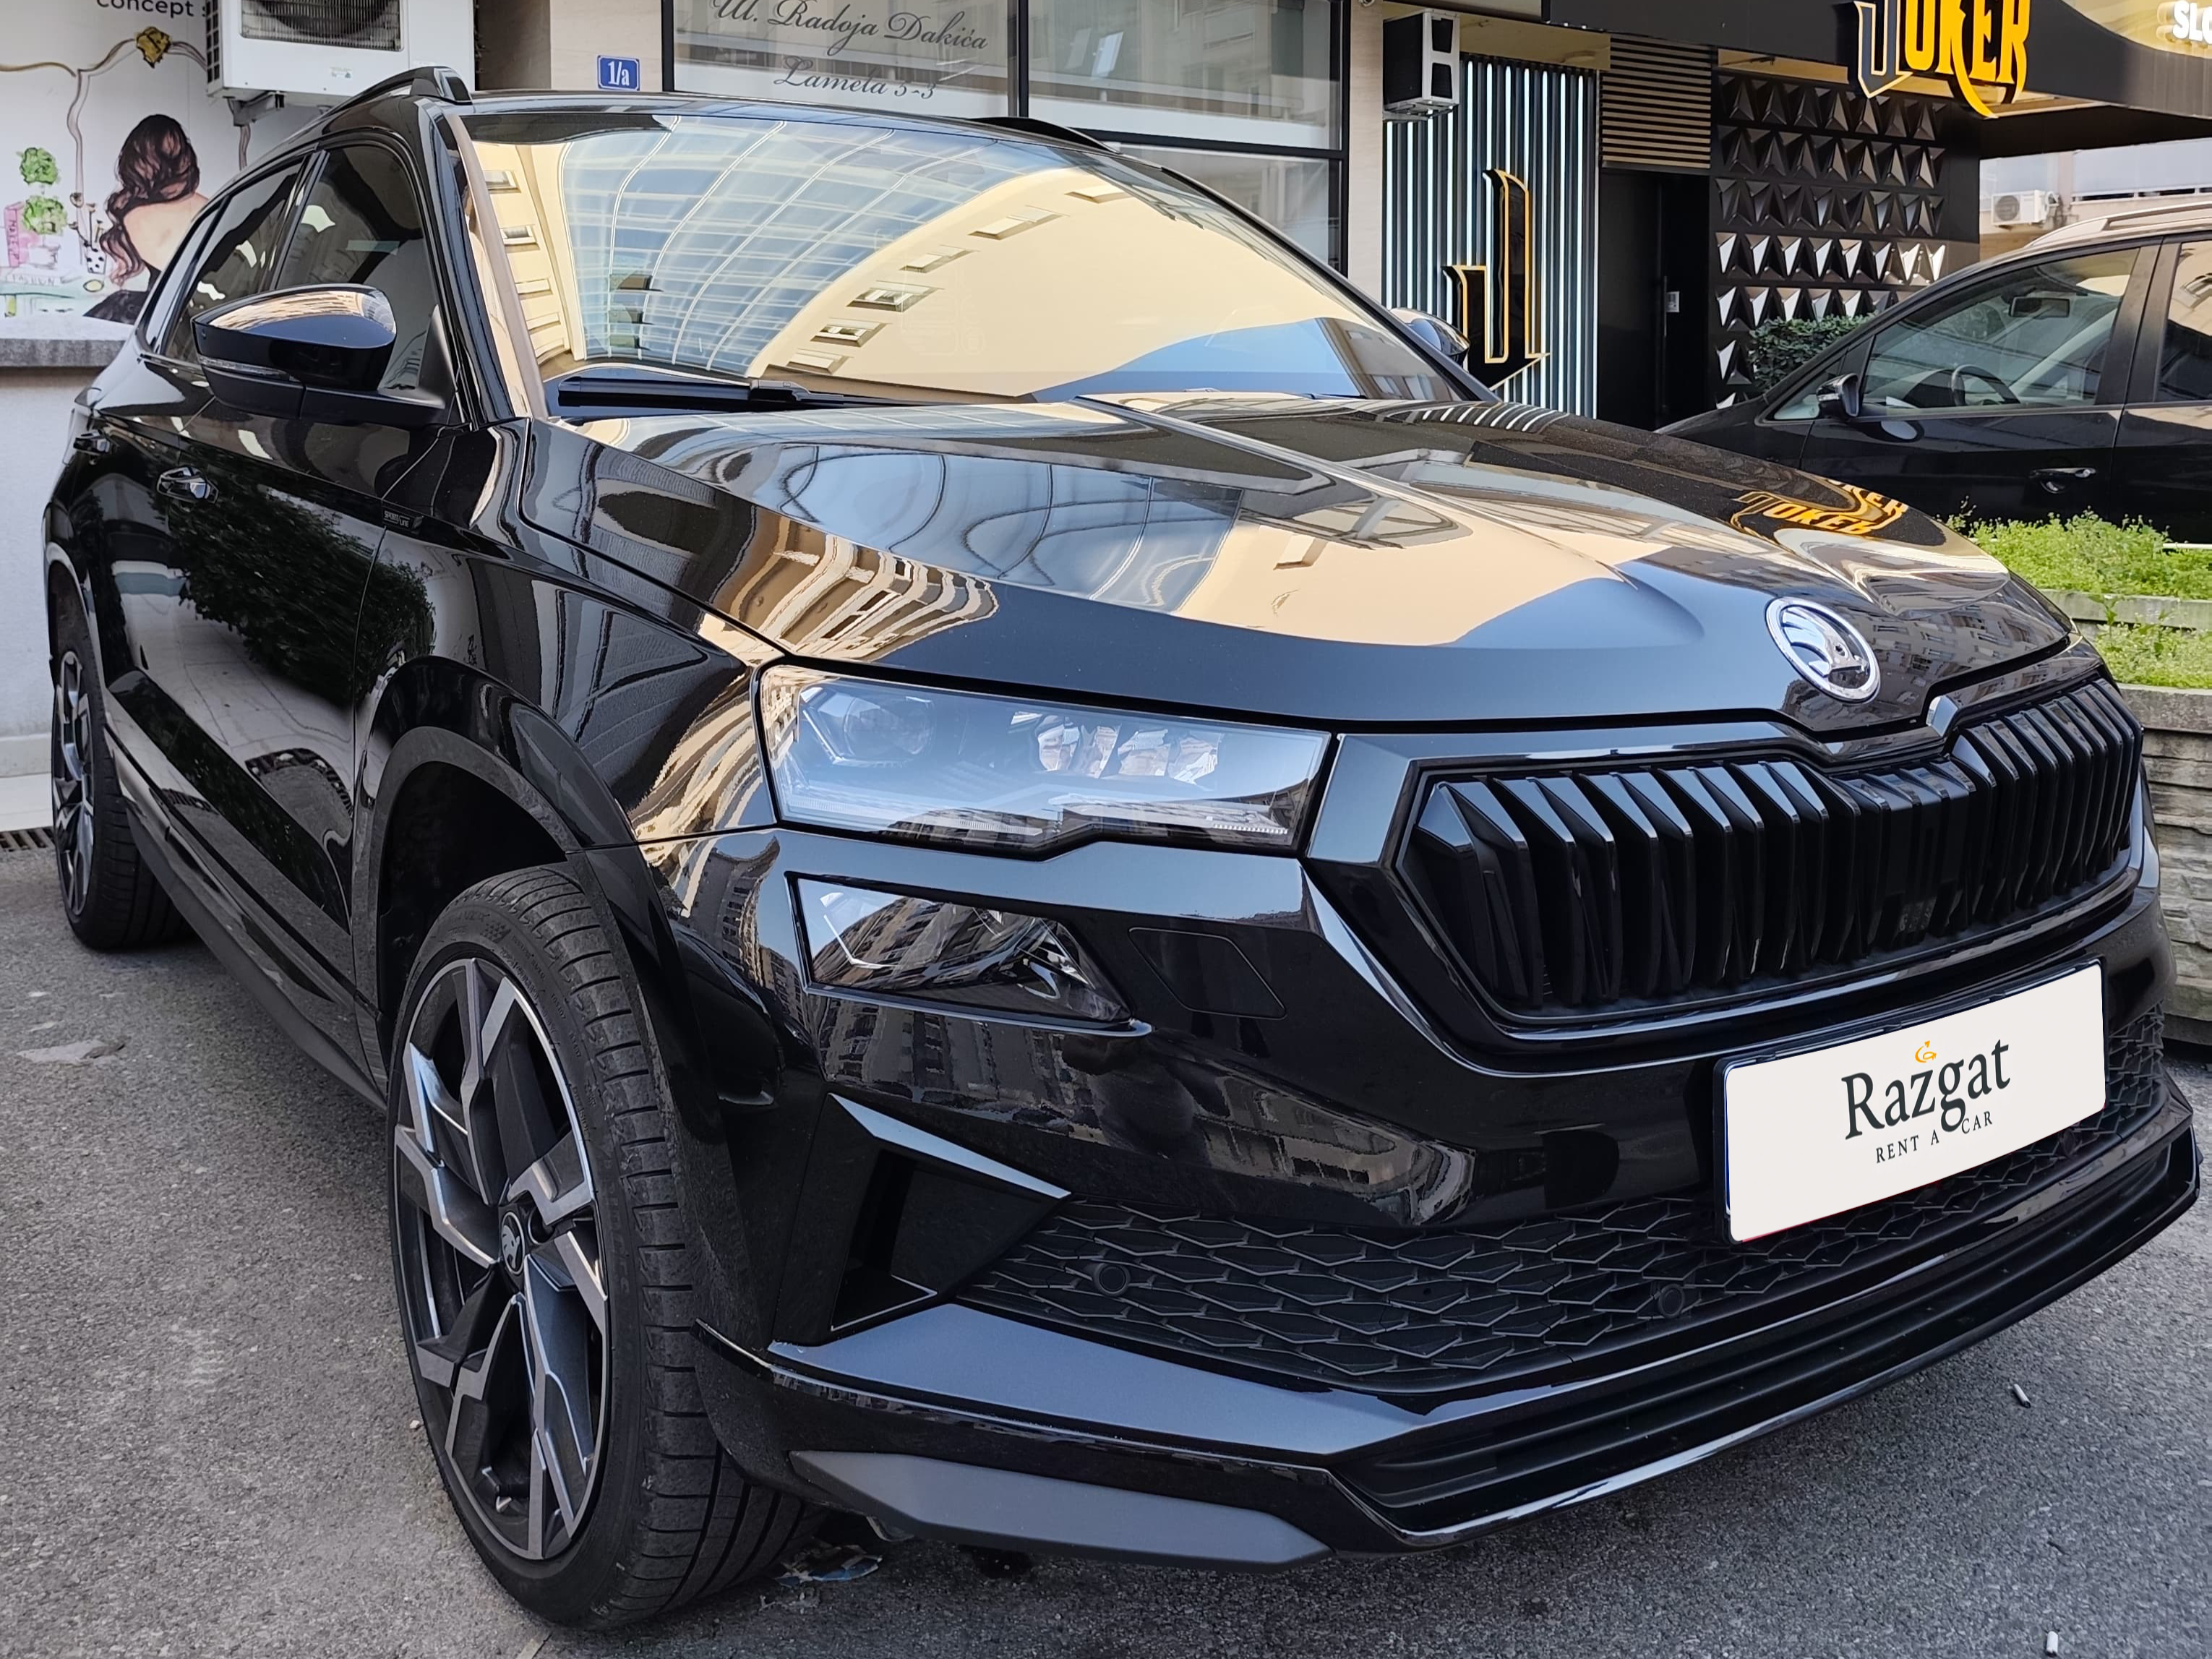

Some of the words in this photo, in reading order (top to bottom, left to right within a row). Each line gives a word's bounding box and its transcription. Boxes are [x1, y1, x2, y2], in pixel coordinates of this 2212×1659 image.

[97, 0, 194, 19] concept
[767, 0, 879, 56] Radoja
[884, 11, 987, 50] Dakića
[608, 61, 630, 86] 1/a
[1841, 1039, 2010, 1140] Razgat
[1876, 1135, 1919, 1163] RENT
[1930, 1129, 1939, 1145] A
[1961, 1111, 1992, 1134] CAR
